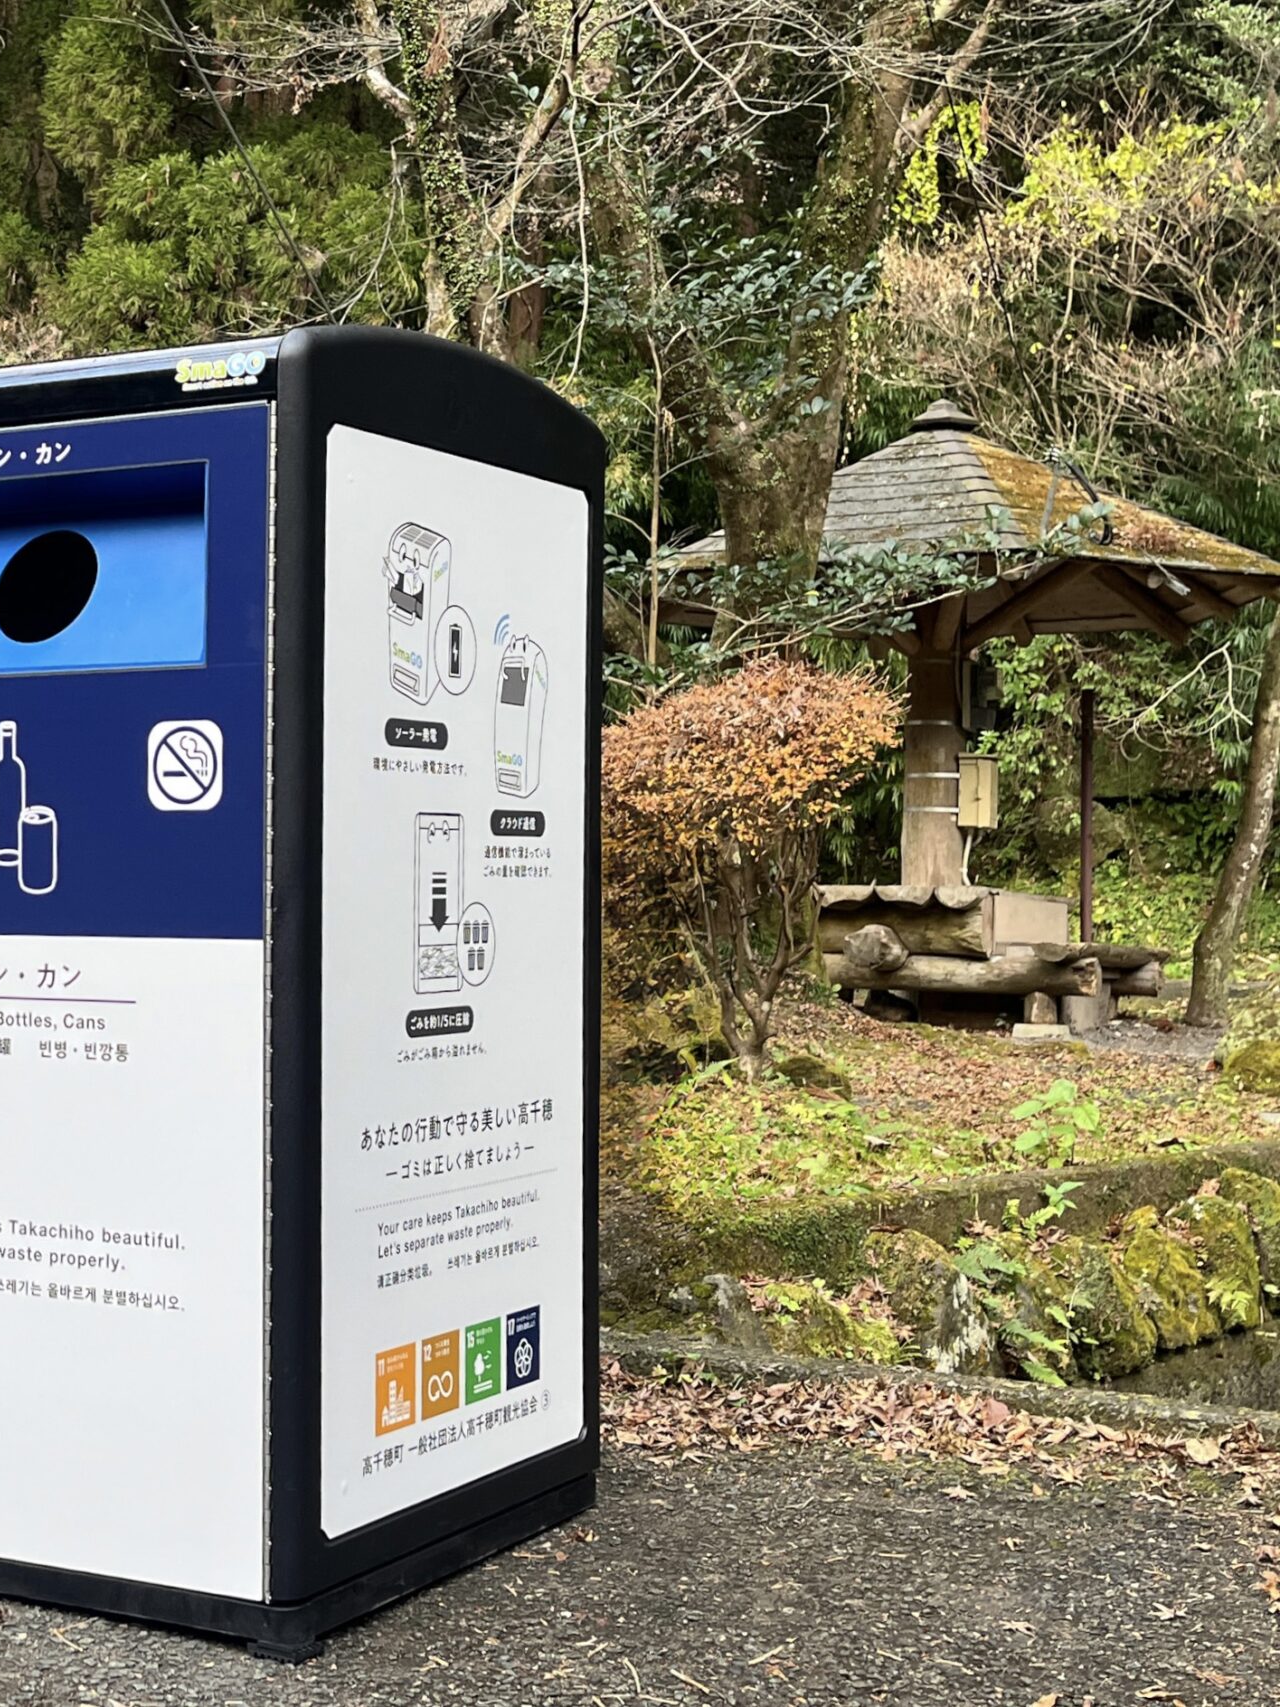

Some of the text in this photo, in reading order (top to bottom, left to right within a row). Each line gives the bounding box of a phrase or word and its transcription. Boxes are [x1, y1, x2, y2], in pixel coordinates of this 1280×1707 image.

[175, 351, 266, 383] SmaGO
[63, 1013, 106, 1030] Cans
[361, 1098, 553, 1151] あなたの行動で守る美しい高千穂
[377, 1222, 400, 1237] Your
[402, 1217, 423, 1231] care
[426, 1209, 452, 1226] keeps
[455, 1200, 499, 1219] Takachiho
[9, 1219, 95, 1242] Takachiho
[102, 1227, 186, 1250] beautiful.
[378, 1216, 513, 1260] Let's separate waste properly.
[49, 1251, 126, 1273] properly.
[47, 1283, 97, 1303] 올바르게
[508, 1318, 516, 1336] 17
[423, 1344, 432, 1362] 12
[377, 1358, 385, 1377] 11
[362, 1444, 404, 1477] 高千穂町
